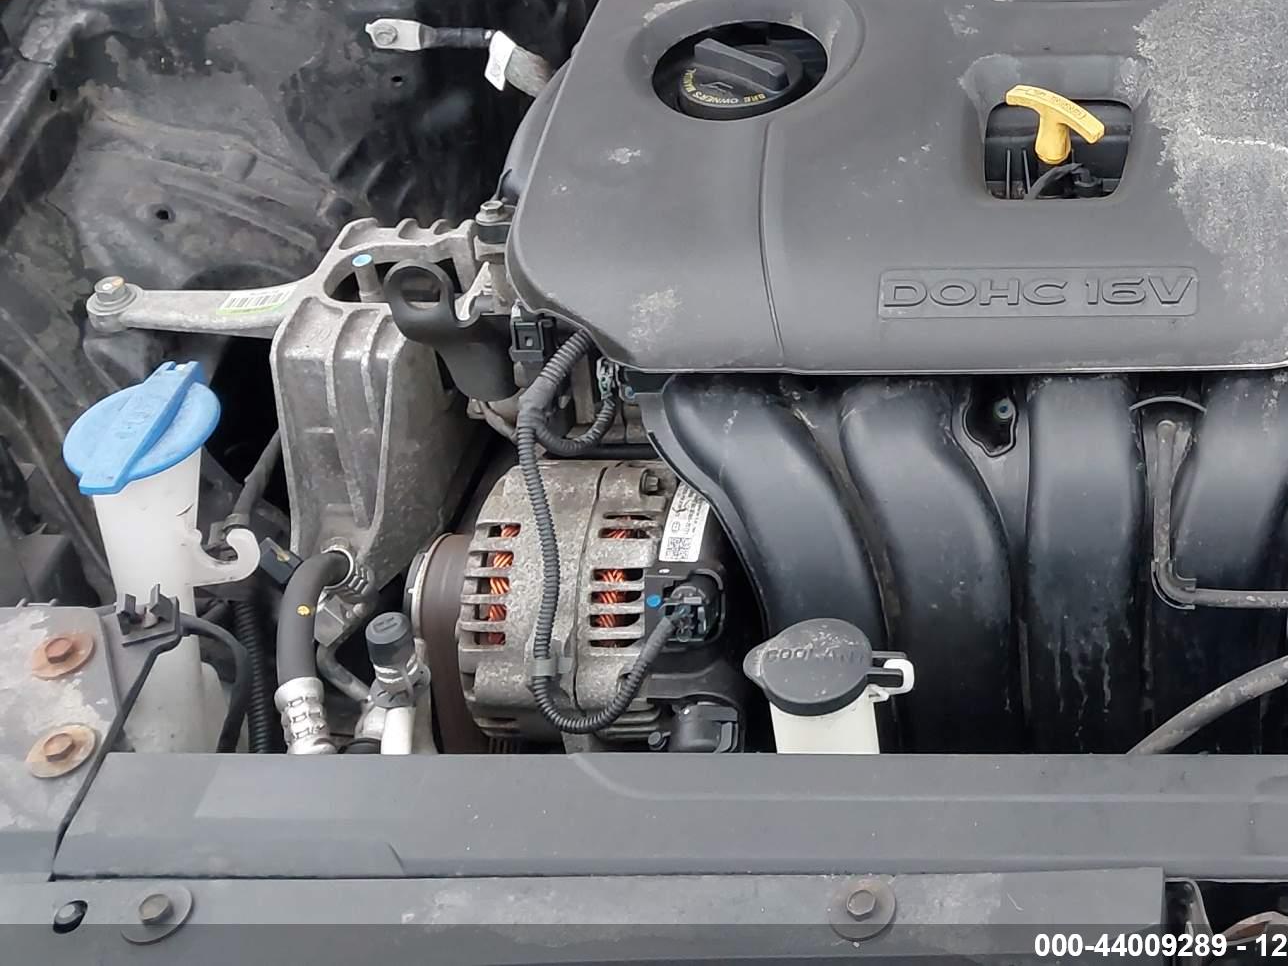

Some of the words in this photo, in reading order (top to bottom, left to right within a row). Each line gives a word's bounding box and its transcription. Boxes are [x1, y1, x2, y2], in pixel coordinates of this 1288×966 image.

[693, 91, 739, 104] OWNERS
[883, 278, 1068, 307] DOHC
[1086, 277, 1195, 306] 16V
